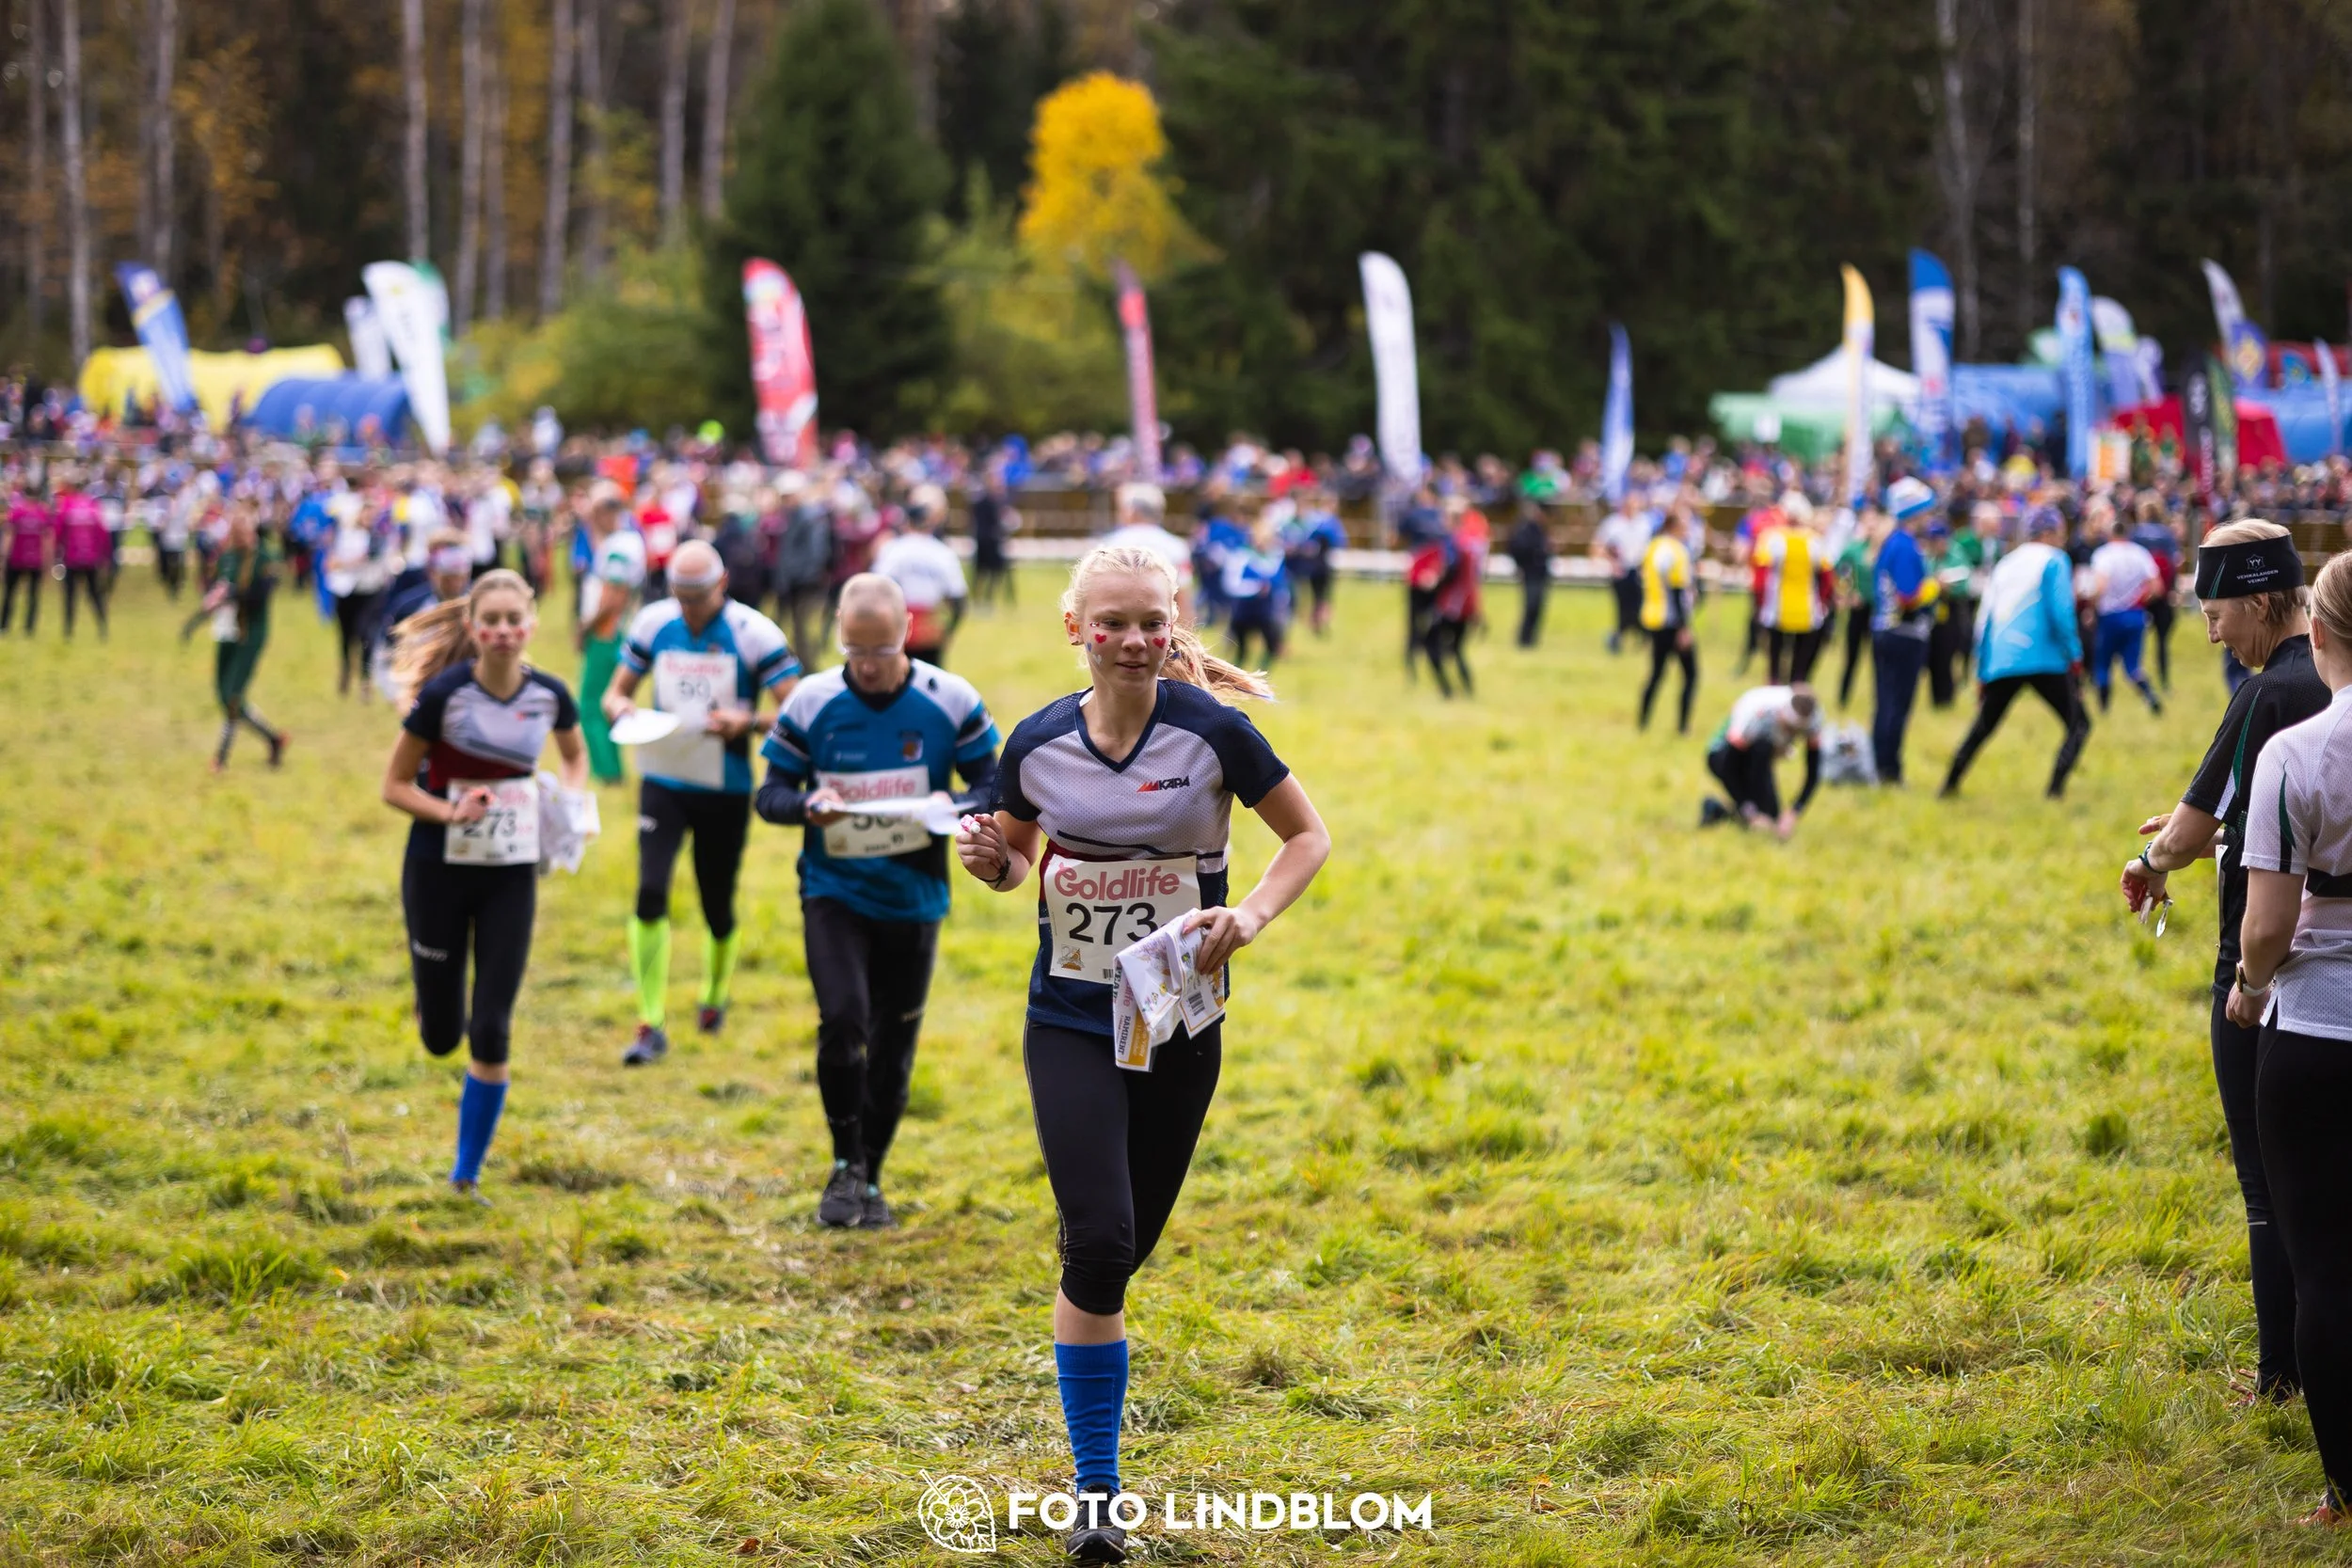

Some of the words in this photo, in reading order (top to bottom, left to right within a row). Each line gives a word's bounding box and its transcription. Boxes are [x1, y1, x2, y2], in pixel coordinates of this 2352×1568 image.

[1055, 864, 1180, 900] Goldlife
[1066, 902, 1158, 945] 273
[1118, 1016, 1131, 1055] RAMIRENT
